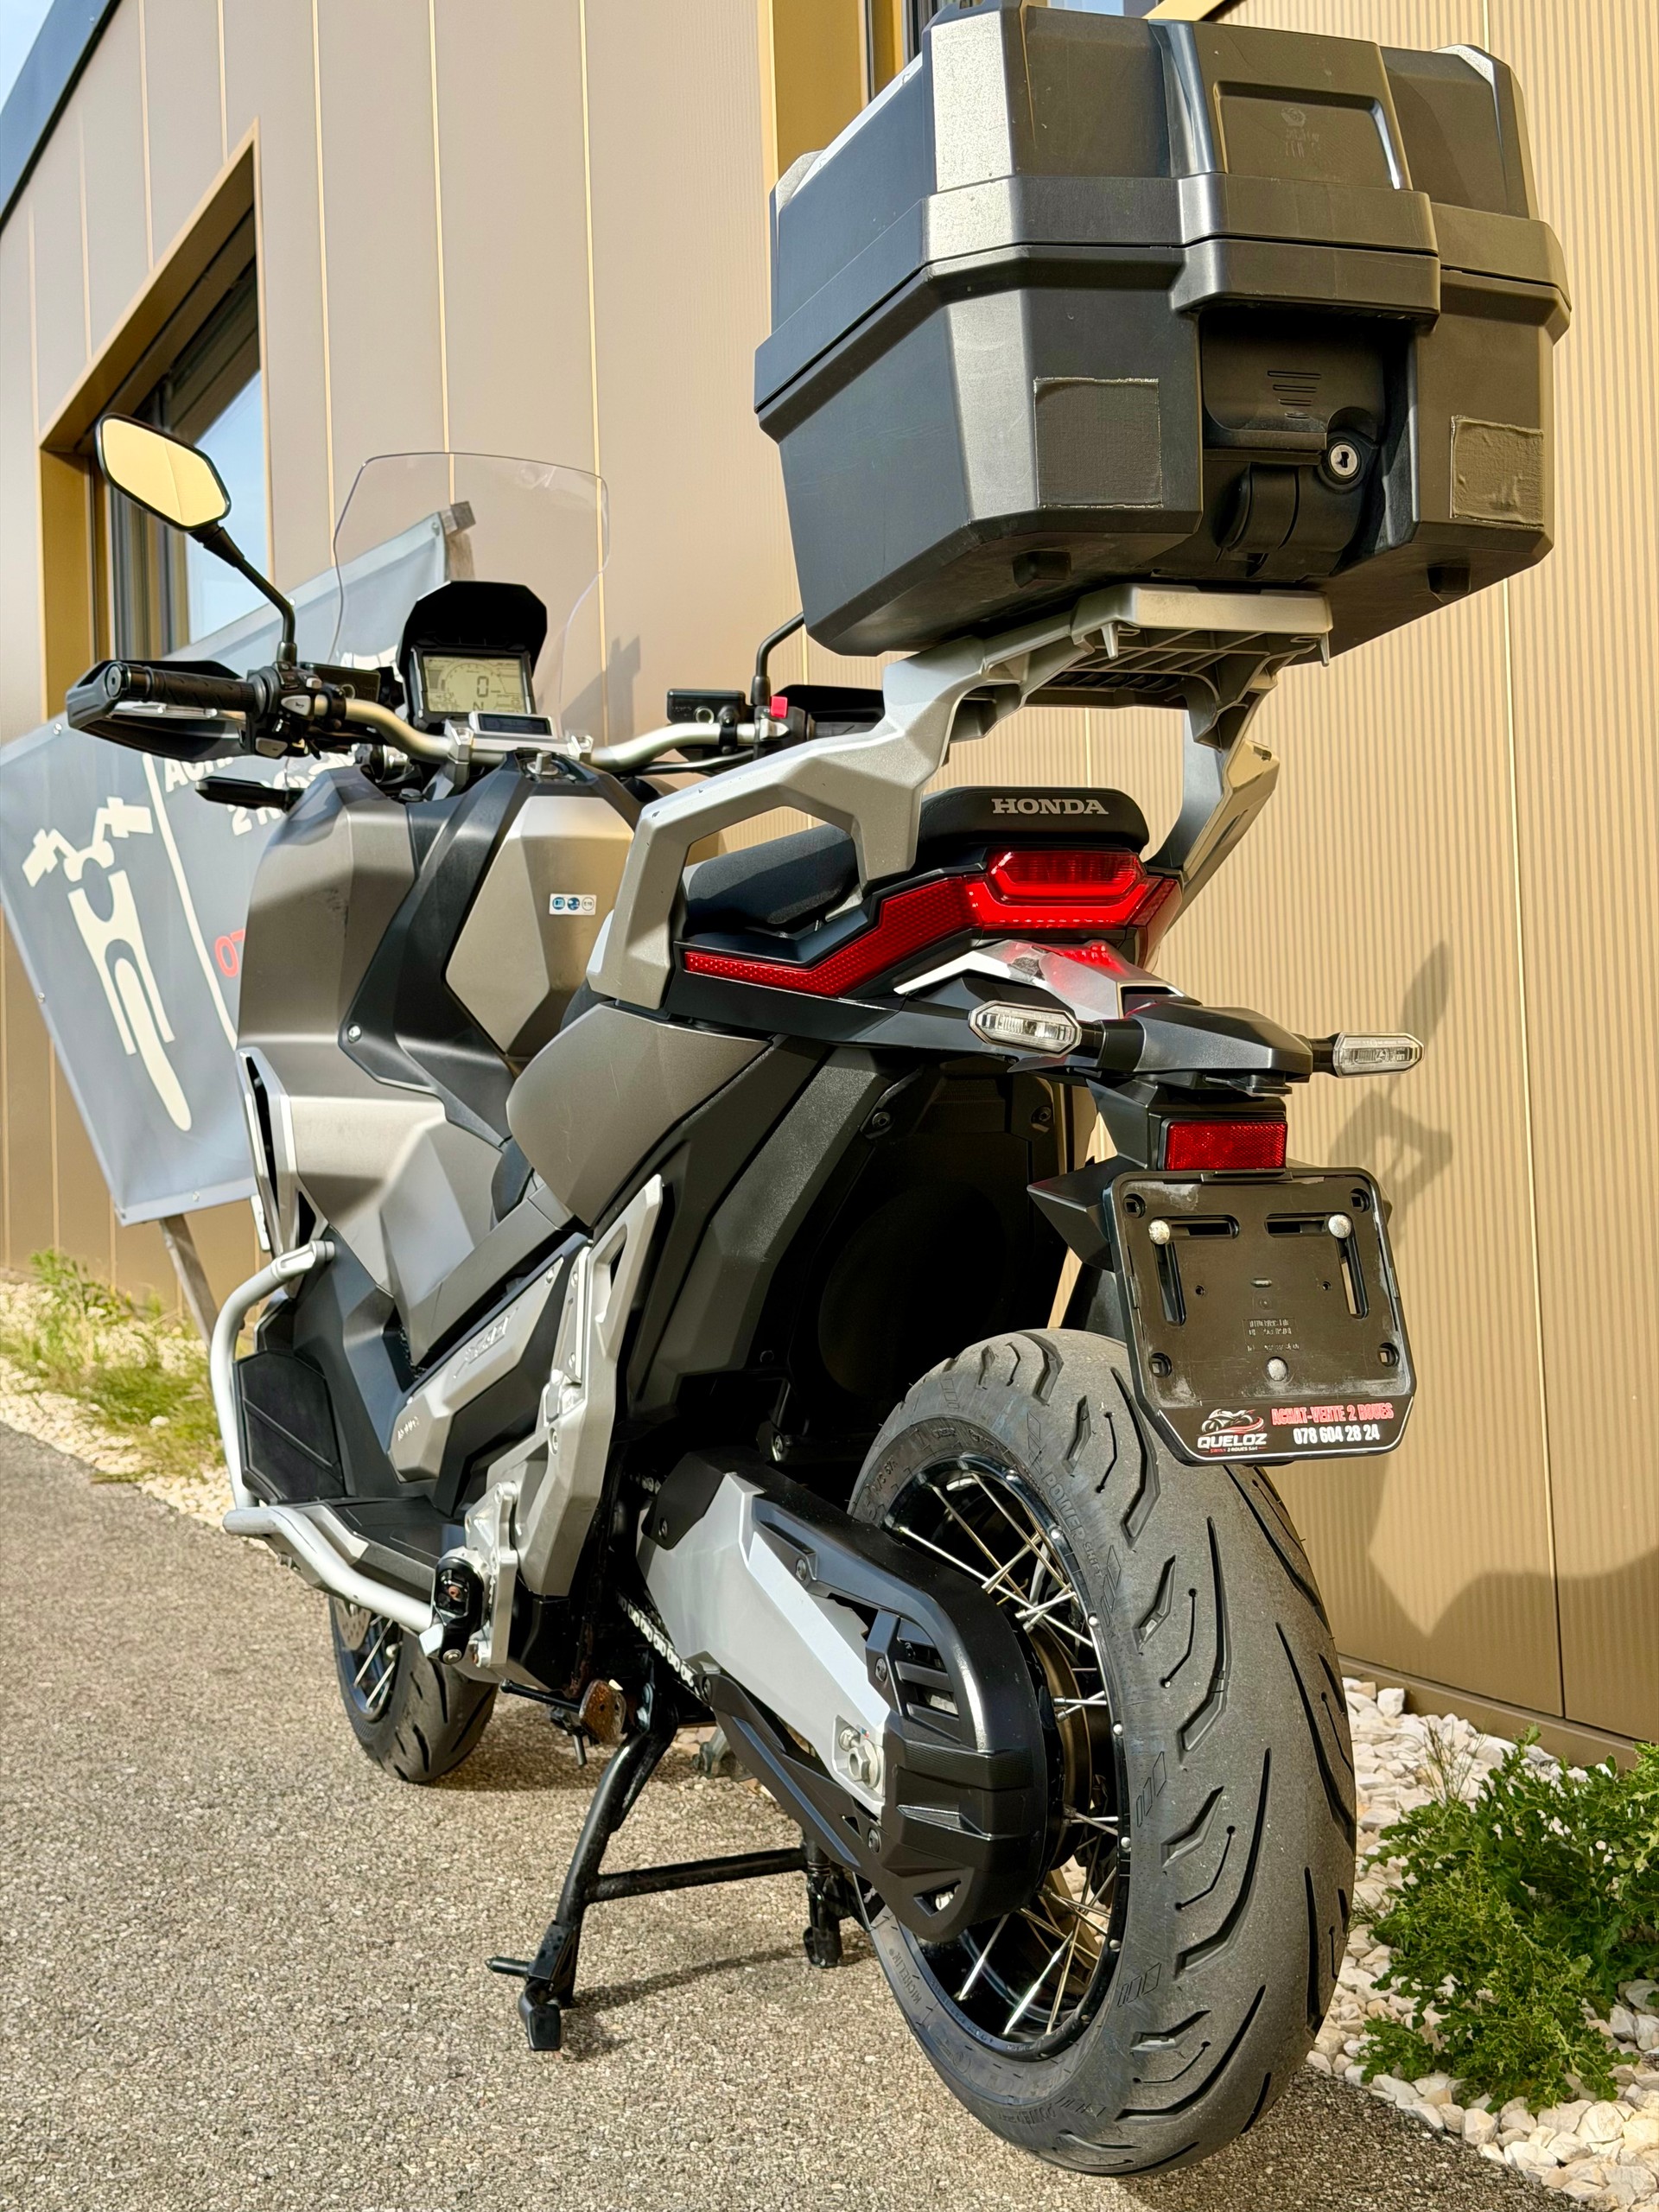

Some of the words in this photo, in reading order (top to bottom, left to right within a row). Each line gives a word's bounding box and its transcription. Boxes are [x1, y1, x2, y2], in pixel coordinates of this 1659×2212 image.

[477, 676, 488, 698] 0
[991, 798, 1109, 815] HONDA
[215, 927, 246, 979] 0
[1271, 1404, 1347, 1426] ACHAT-VENTE
[1346, 1404, 1357, 1421] 2
[1357, 1402, 1395, 1421] ROUES
[1197, 1433, 1268, 1449] QUELOZ
[1293, 1427, 1318, 1445] 078
[1319, 1425, 1344, 1444] 604
[1344, 1424, 1362, 1442] 28
[1363, 1423, 1381, 1441] 24
[1042, 1471, 1086, 1542] POWER
[892, 1952, 922, 2005] MICHELIN
